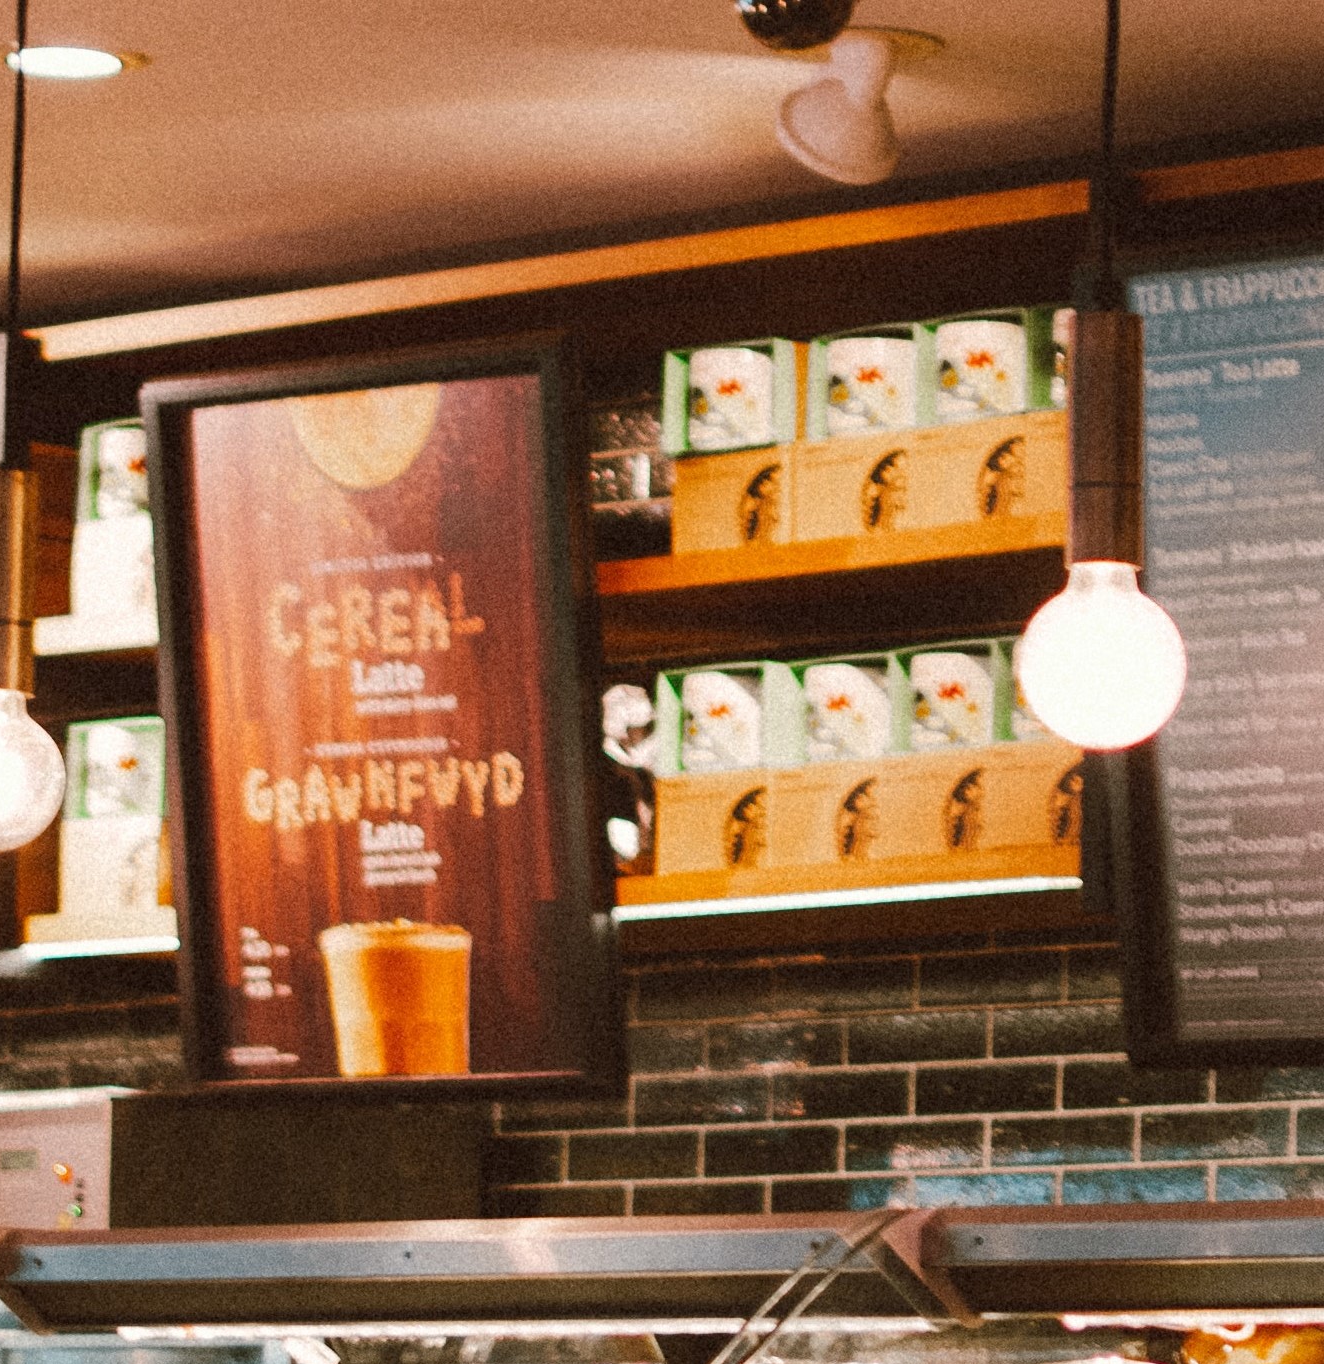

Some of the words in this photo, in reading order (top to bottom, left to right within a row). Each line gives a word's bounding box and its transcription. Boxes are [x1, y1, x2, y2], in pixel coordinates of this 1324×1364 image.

[1132, 283, 1176, 315] TEA
[264, 572, 485, 668] CEREAL
[351, 659, 425, 696] Latte
[244, 751, 523, 831] GRAWNFWYD
[359, 818, 425, 853] Latte
